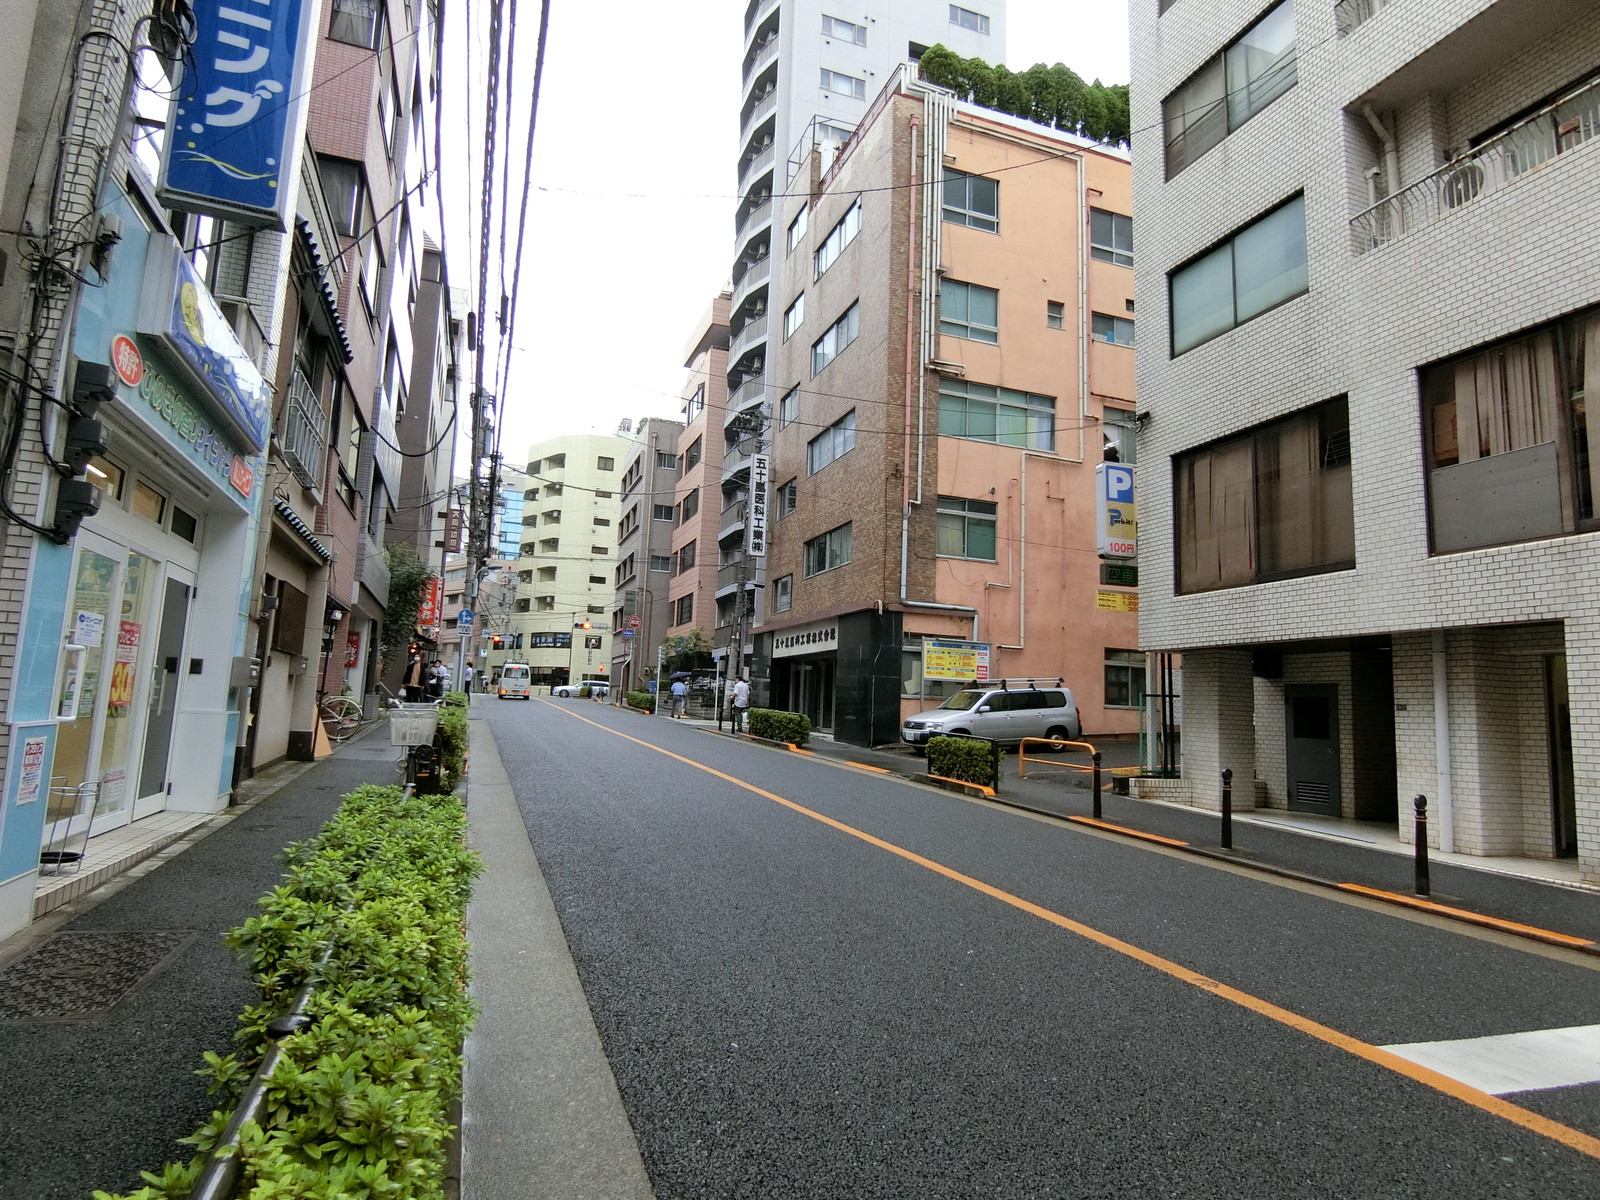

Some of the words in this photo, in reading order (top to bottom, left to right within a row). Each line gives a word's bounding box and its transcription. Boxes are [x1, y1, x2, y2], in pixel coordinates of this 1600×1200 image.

[118, 342, 141, 379] 特許
[1108, 469, 1131, 499] P
[1109, 542, 1135, 554] 100円
[1108, 568, 1135, 583] 空車
